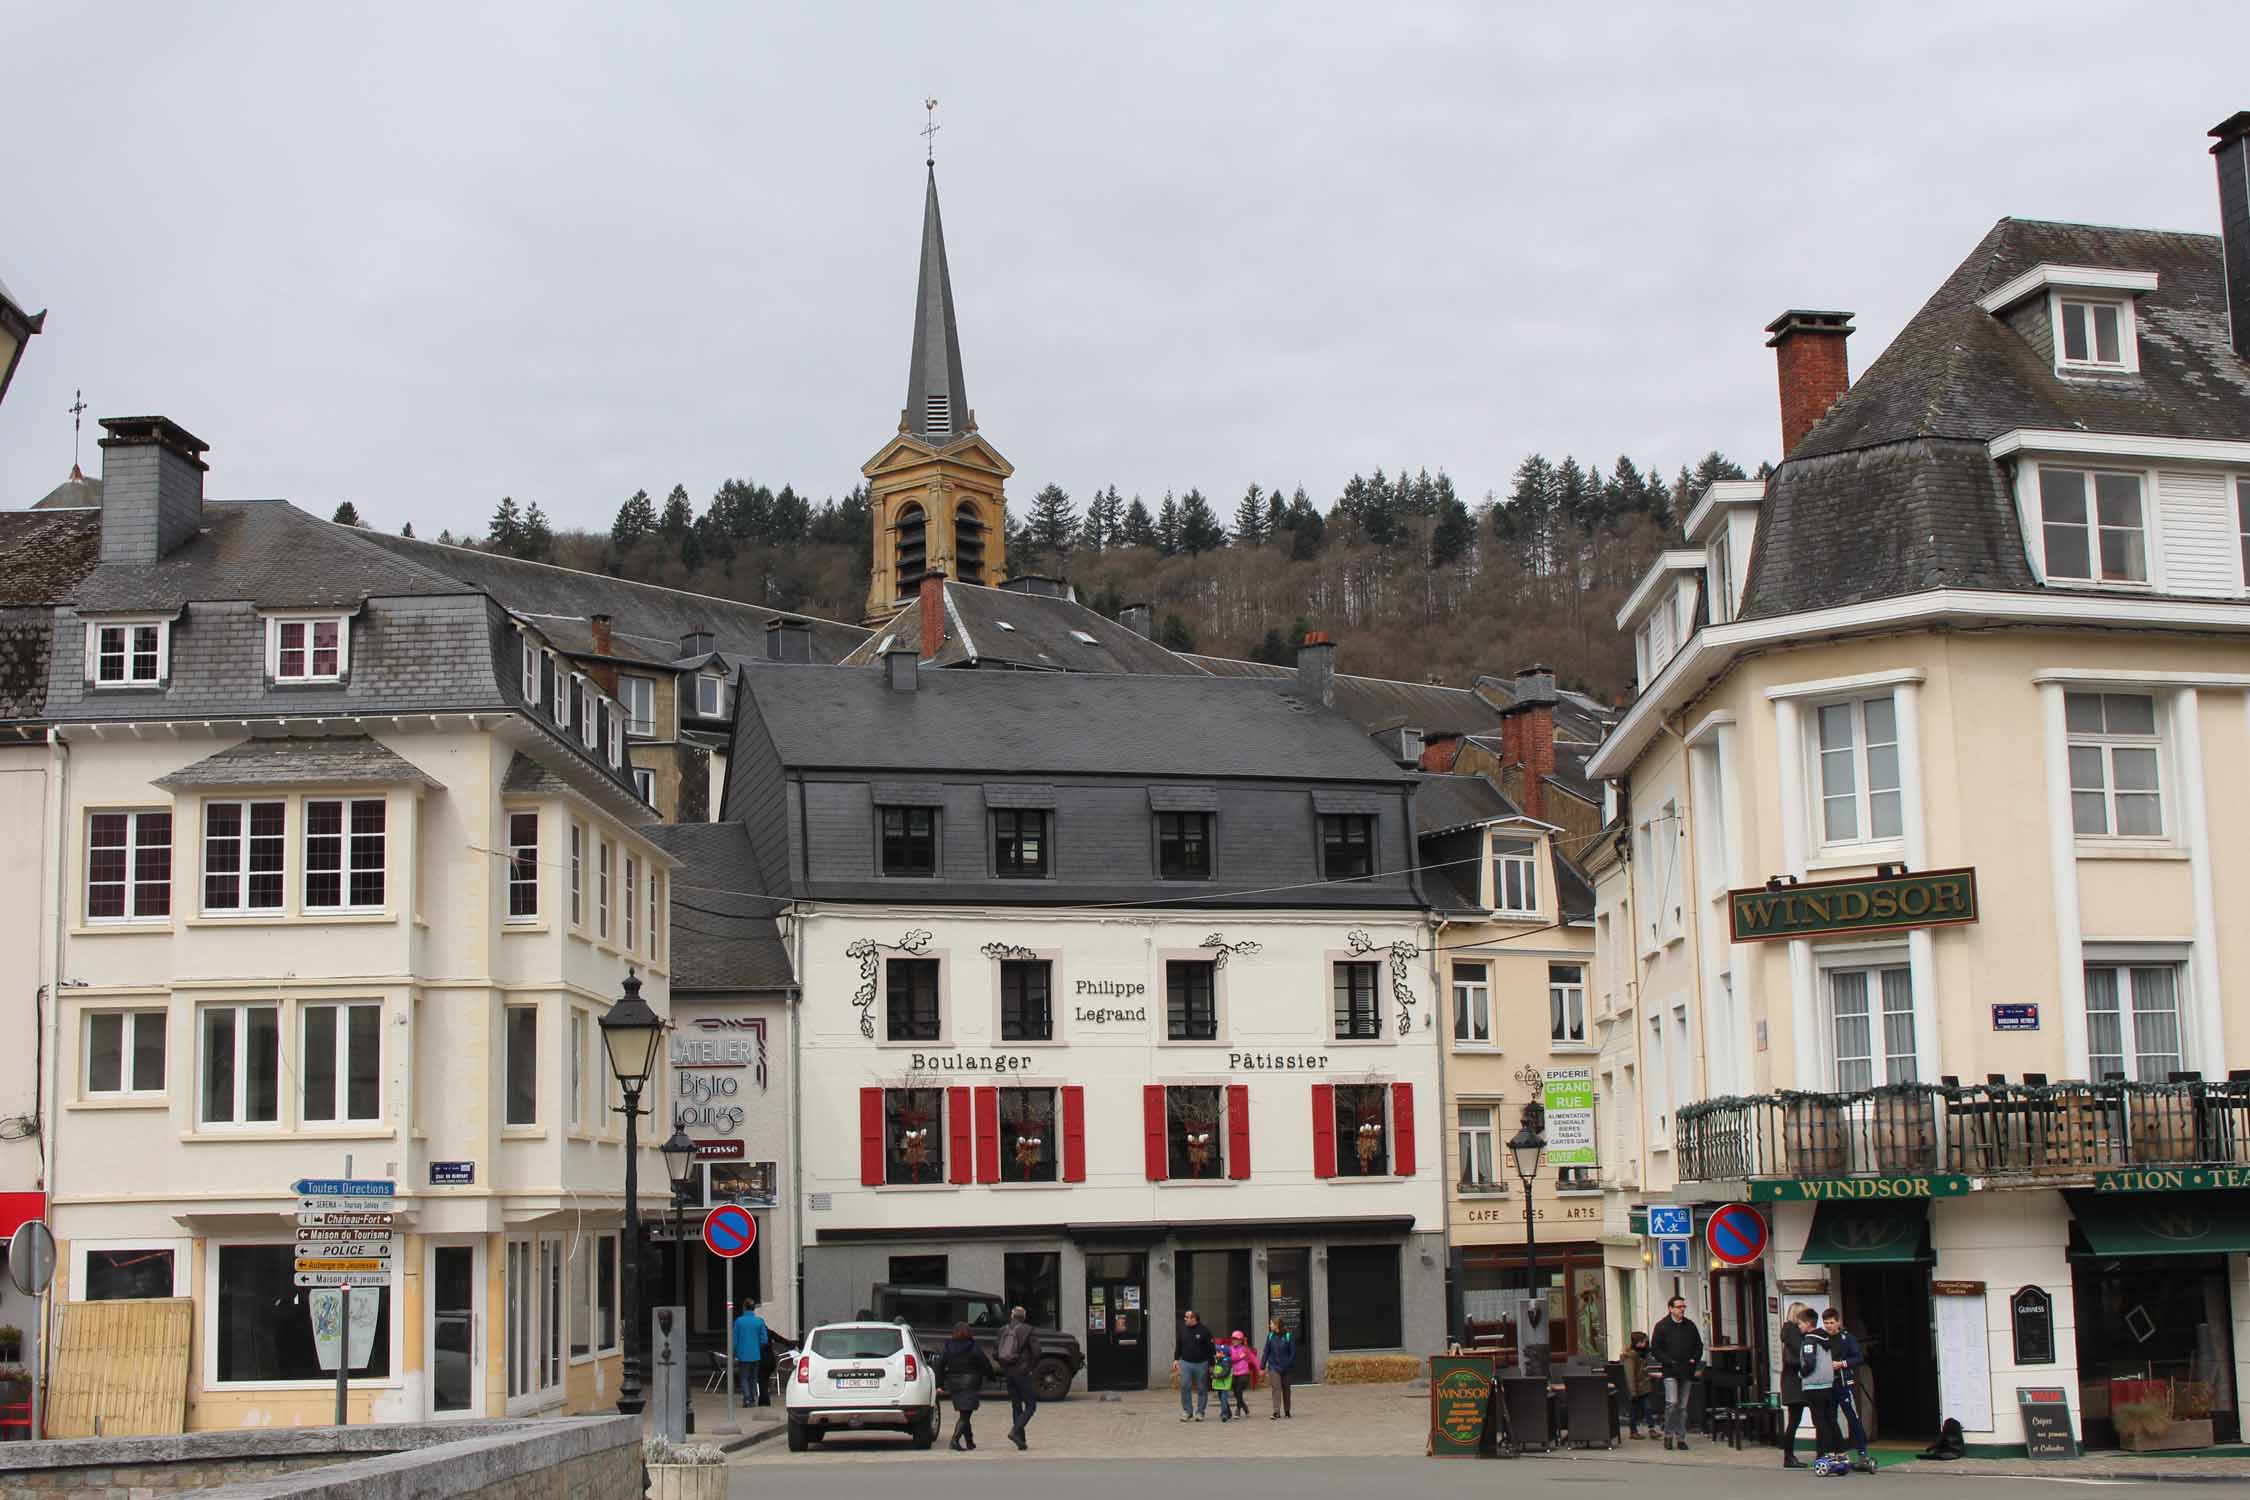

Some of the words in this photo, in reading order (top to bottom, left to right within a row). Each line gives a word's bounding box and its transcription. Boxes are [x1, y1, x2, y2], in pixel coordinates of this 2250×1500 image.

[1738, 881, 1965, 929] WINDSOR
[1075, 980, 1145, 997] Philippe
[1075, 1006, 1146, 1024] Legrand
[911, 1053, 1032, 1073] Boulanger
[1228, 1053, 1328, 1069] Pâtissier
[1547, 1070, 1589, 1079] EPICERIE
[680, 1071, 738, 1104] Bistro
[1547, 1082, 1590, 1094] GRAND
[1556, 1096, 1582, 1108] RUE
[674, 1100, 744, 1134] Lounge
[307, 1182, 338, 1194] Toutes
[342, 1183, 390, 1194] Directions
[1799, 1178, 1932, 1199] WINDSOR
[2101, 1171, 2184, 1191] ATION
[1567, 1208, 1595, 1218] ARTS
[311, 1230, 339, 1240] Maison
[341, 1230, 352, 1239] du
[354, 1230, 389, 1240] Tourisme
[323, 1245, 365, 1256] POLICE
[316, 1274, 341, 1283] Maison
[344, 1274, 356, 1284] des
[359, 1275, 384, 1285] jeunes
[1440, 1386, 1489, 1400] WINDSOR
